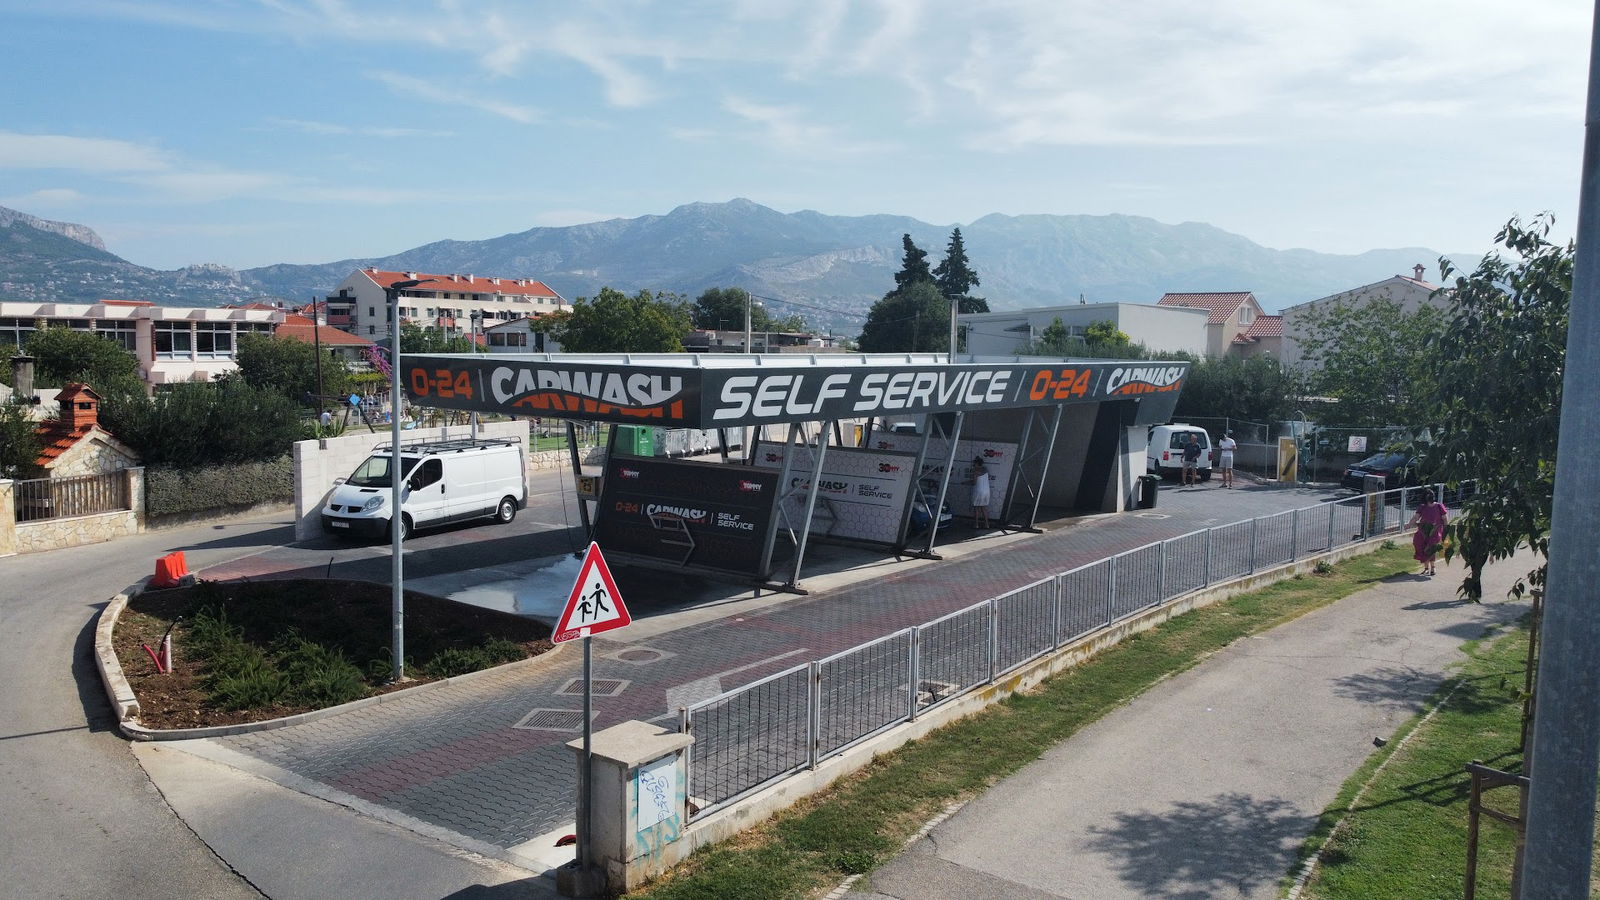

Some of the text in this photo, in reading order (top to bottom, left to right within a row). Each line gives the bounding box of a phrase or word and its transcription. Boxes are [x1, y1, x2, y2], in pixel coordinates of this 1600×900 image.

[411, 366, 683, 419] 0-24 CARWASH
[712, 366, 1186, 420] SELF SERVICE 0-24 CARWASH
[859, 490, 893, 499] SERVICE
[615, 502, 639, 513] 0-24
[717, 512, 741, 521] SELF
[717, 519, 755, 531] SERVICE
